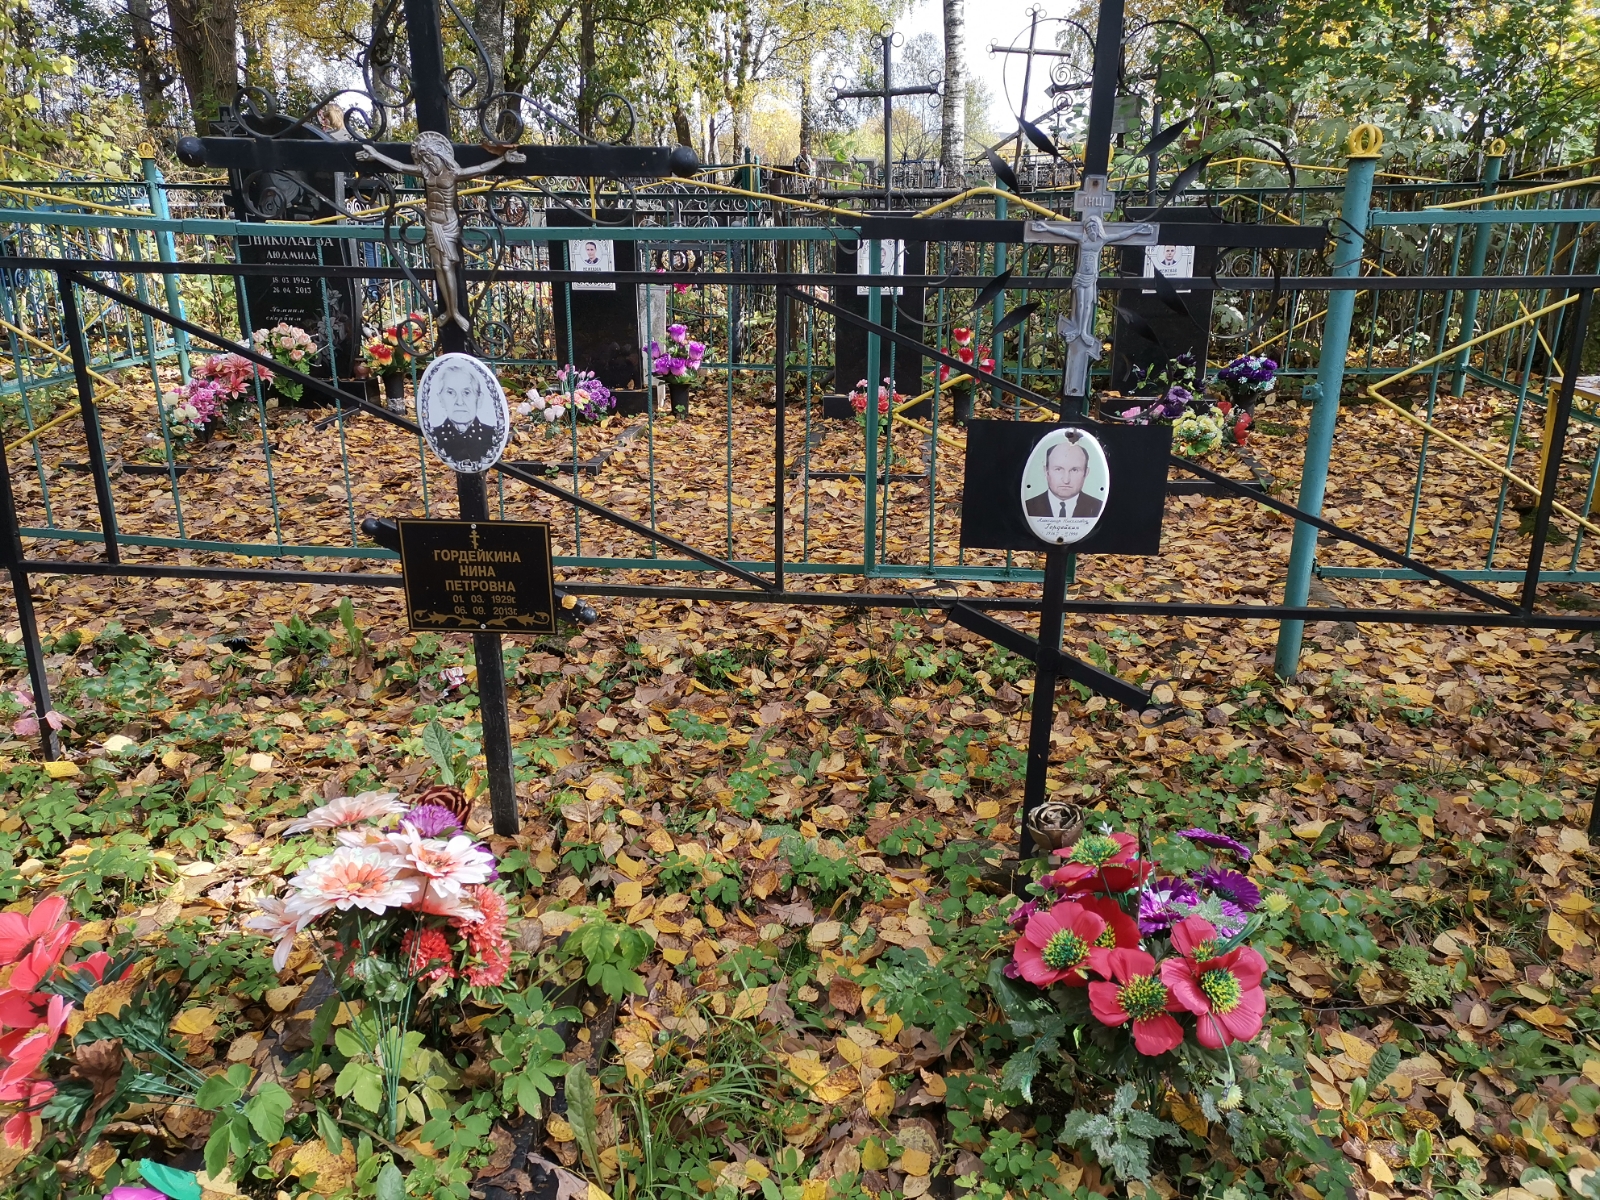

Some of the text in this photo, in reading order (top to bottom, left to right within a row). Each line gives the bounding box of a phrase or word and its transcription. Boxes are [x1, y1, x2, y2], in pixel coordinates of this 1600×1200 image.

[266, 250, 317, 260] ЛЮДМИЛА
[295, 286, 312, 294] 2013
[433, 549, 521, 564] ГОРДЕЙКИНА
[459, 565, 496, 577] НИНА
[445, 580, 516, 592] ПЕТРОВНА
[452, 594, 464, 603] 01.
[470, 595, 485, 604] 03.
[454, 606, 518, 615] 06. 09. 2013г.
